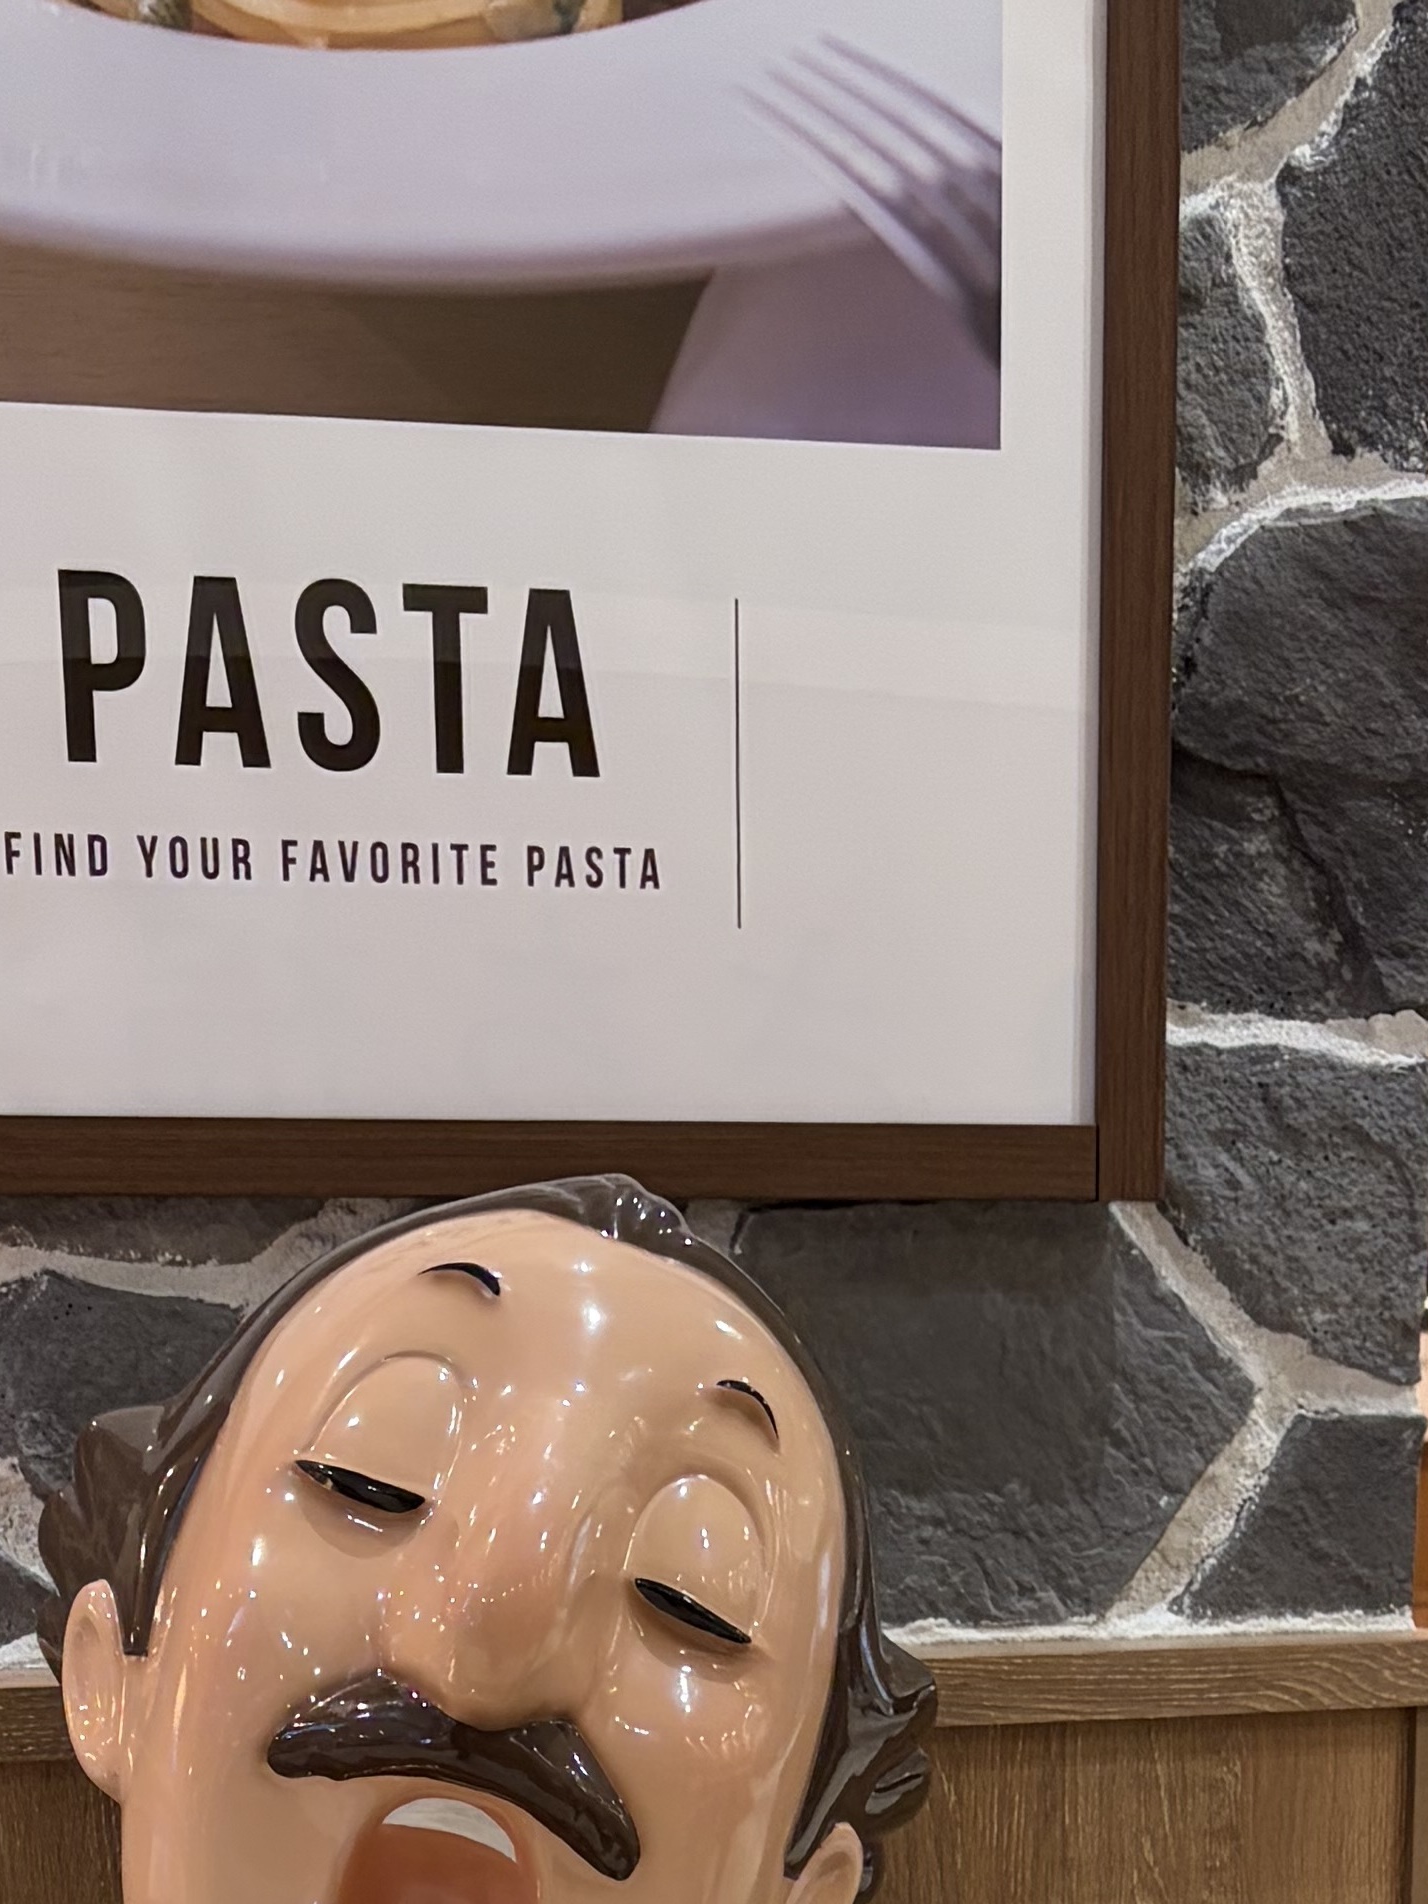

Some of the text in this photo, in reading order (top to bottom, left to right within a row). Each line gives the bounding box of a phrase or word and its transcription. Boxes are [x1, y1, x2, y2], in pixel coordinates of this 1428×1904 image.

[57, 569, 600, 777] PASTA
[3, 831, 661, 890] FIND YOUR FAVORITE PASTA
